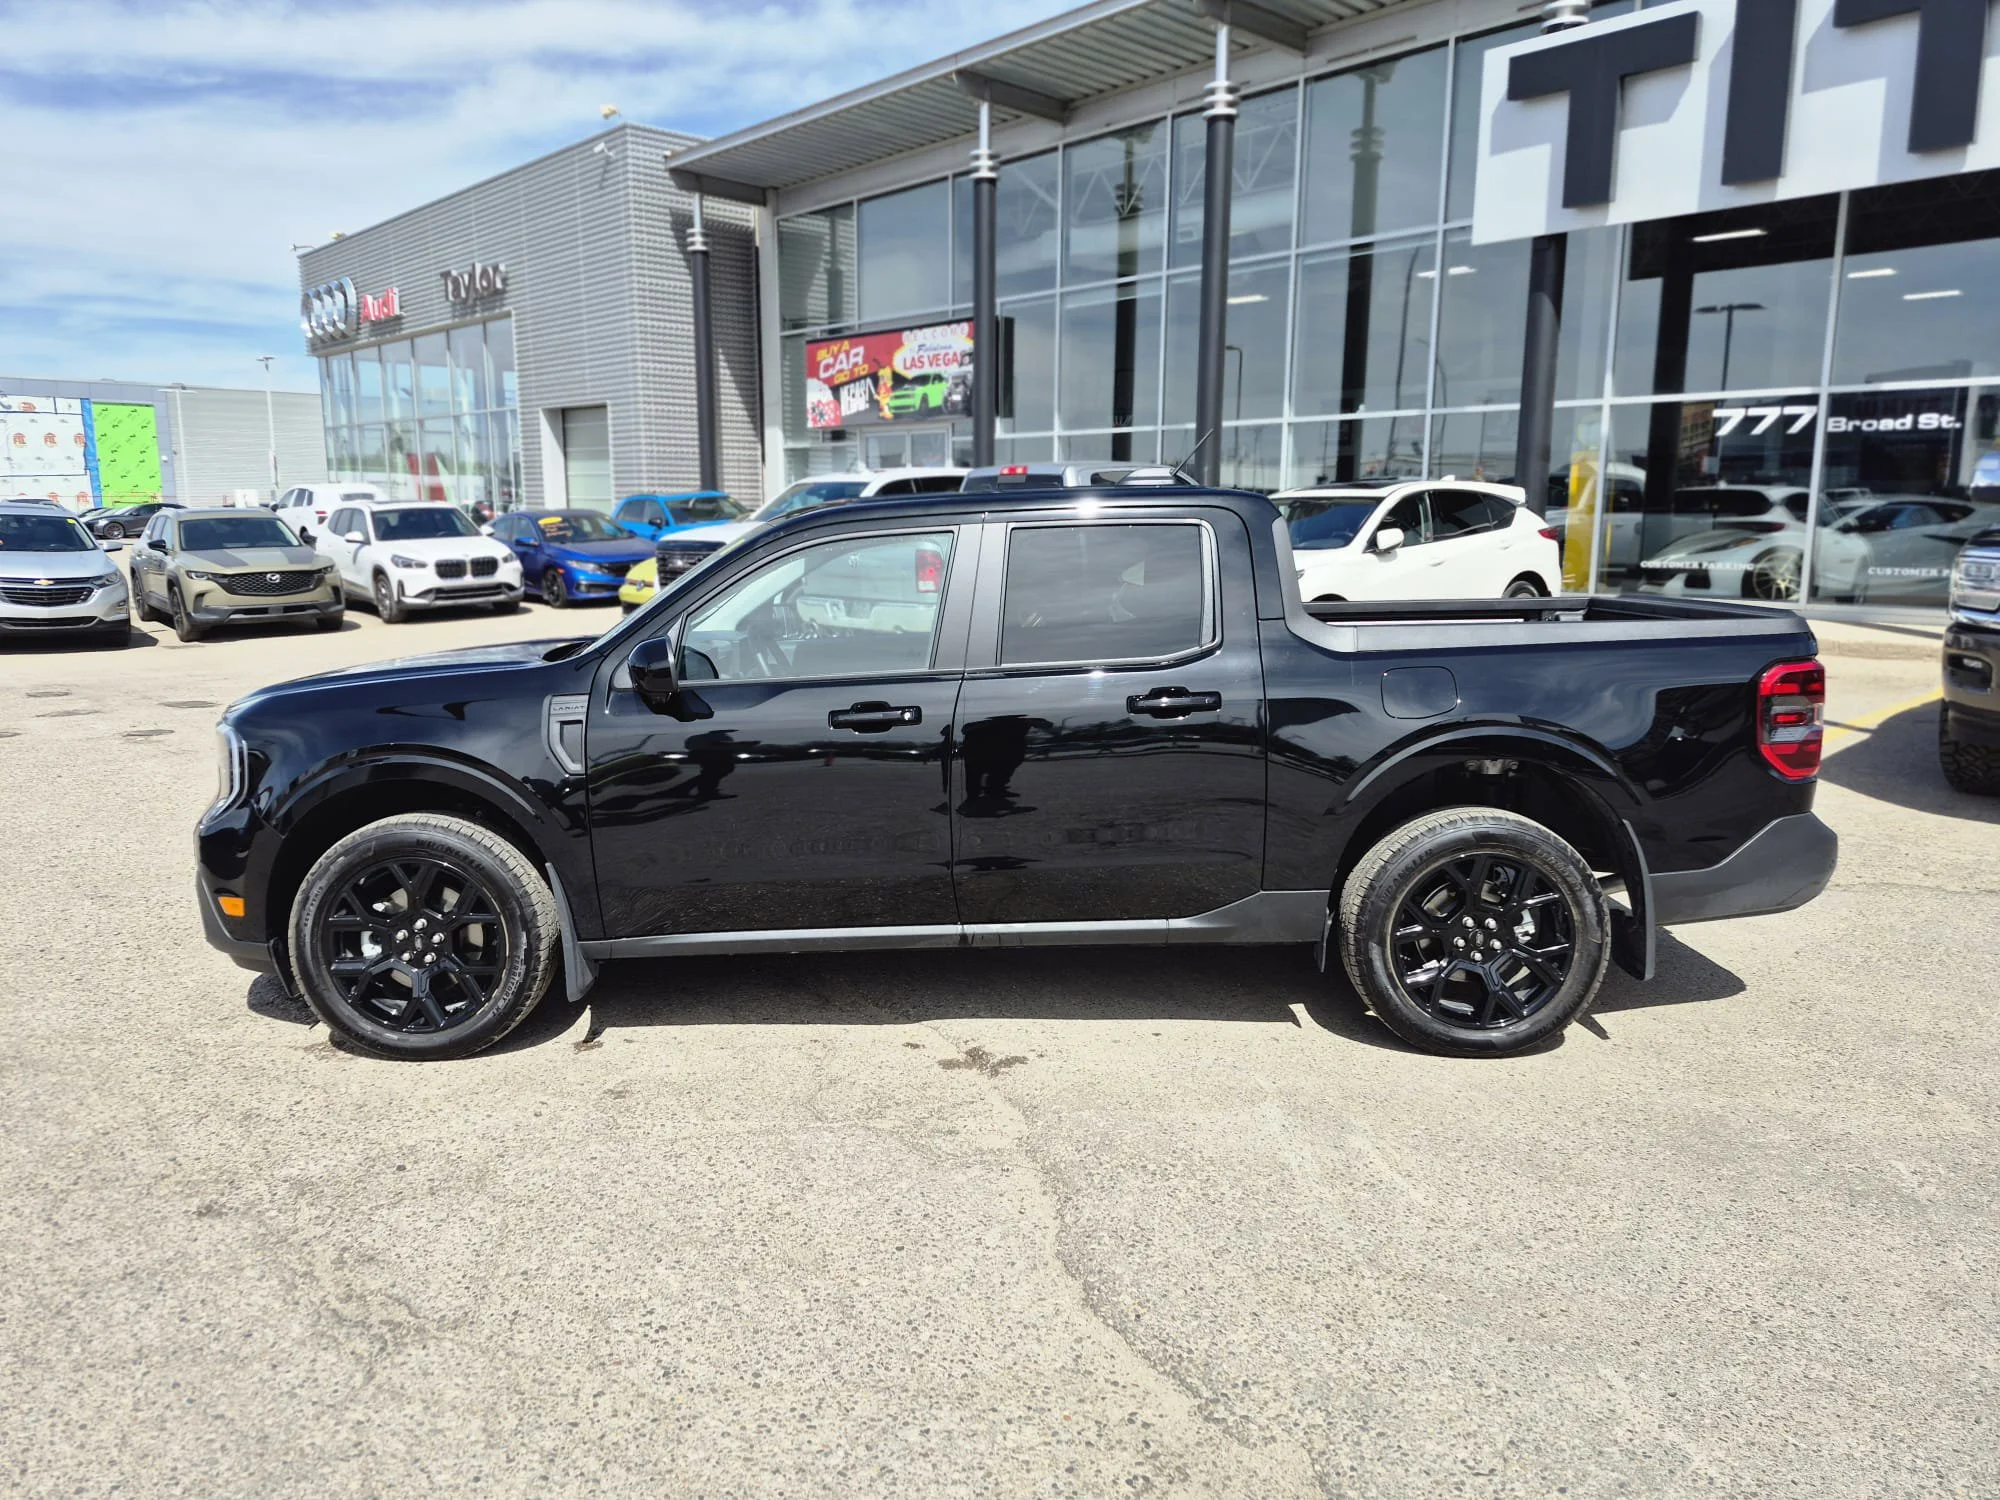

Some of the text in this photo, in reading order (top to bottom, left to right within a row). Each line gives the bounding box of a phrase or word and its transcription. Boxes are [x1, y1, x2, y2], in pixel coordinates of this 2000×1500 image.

[440, 262, 506, 306] Taylor
[361, 287, 399, 323] Audi
[816, 339, 850, 362] BUY A
[819, 345, 865, 379] CAR
[903, 354, 925, 370] LAS
[834, 363, 869, 385] GO TO
[1711, 405, 1961, 437] 777 Broad St.
[1867, 566, 1939, 577] CUSTOMER
